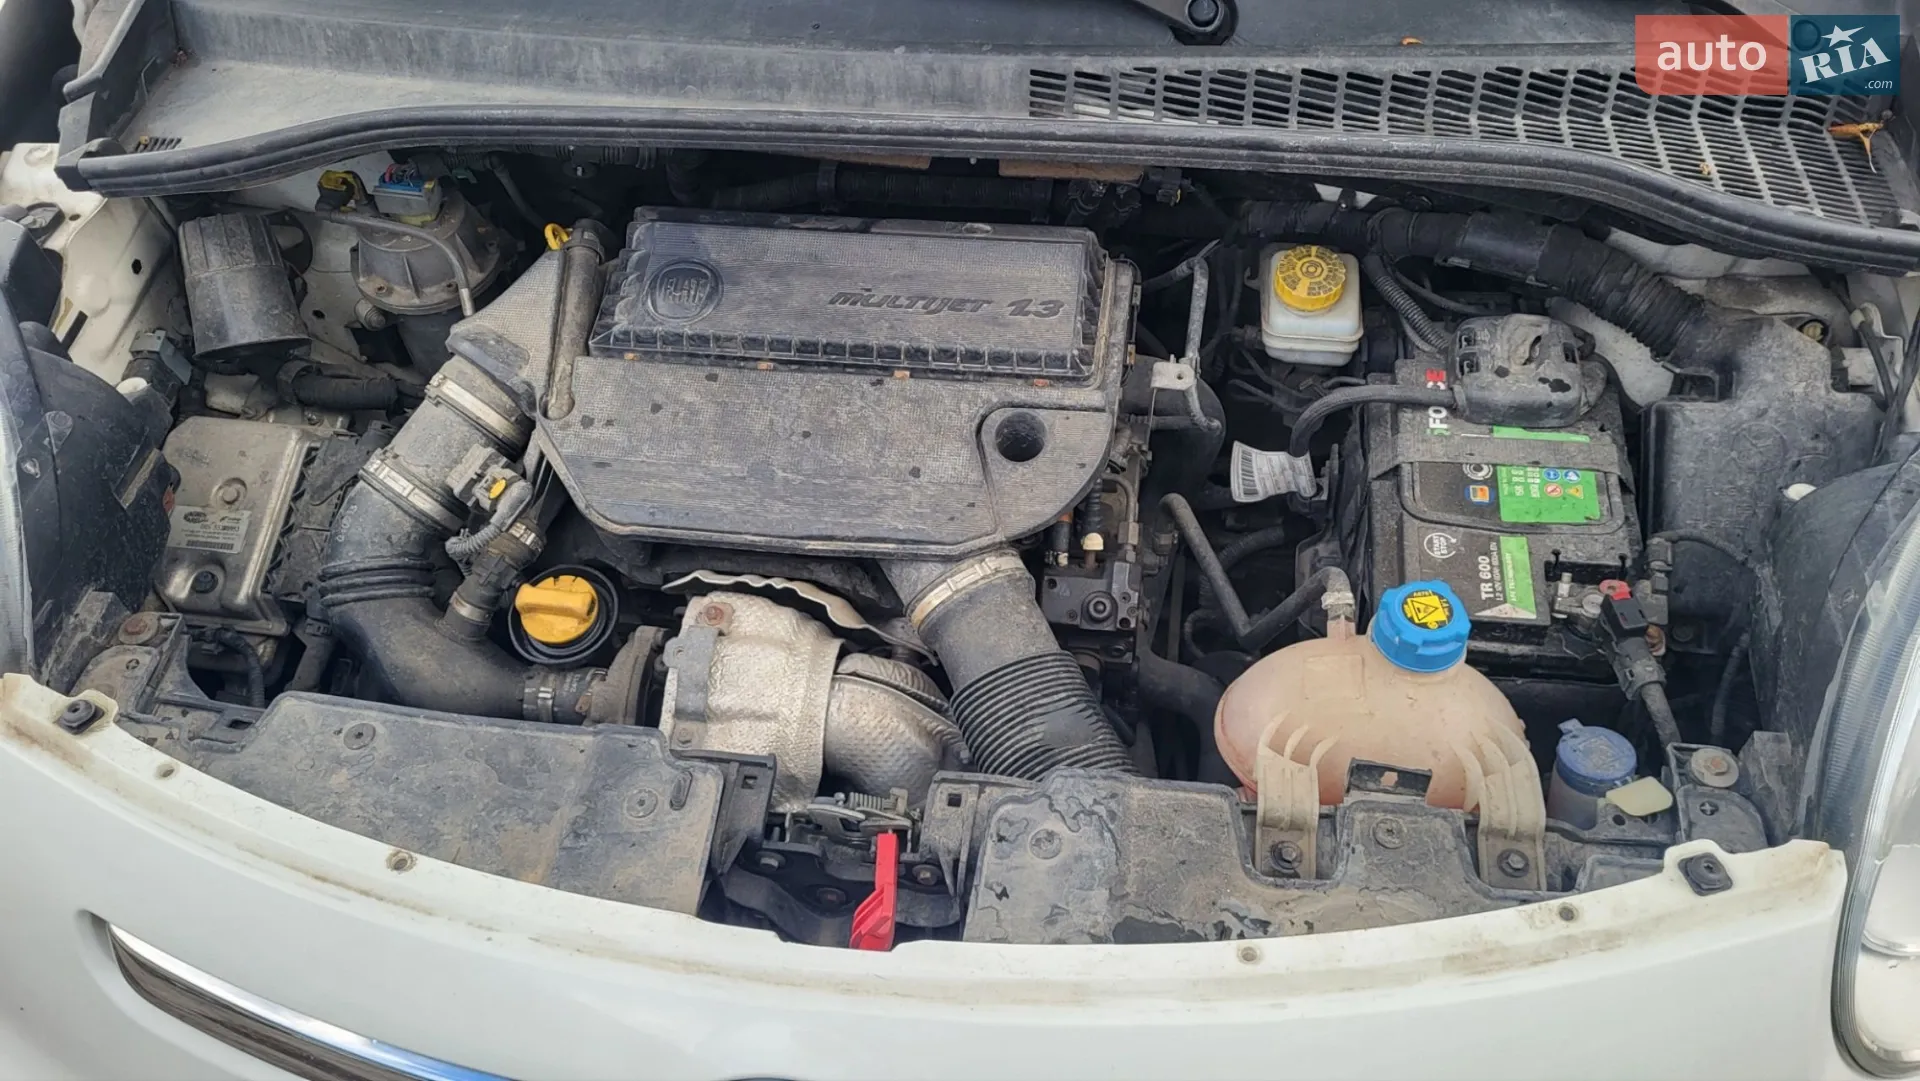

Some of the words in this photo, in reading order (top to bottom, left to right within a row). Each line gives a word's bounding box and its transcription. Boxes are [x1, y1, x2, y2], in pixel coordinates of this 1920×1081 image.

[1433, 535, 1441, 555] START
[1440, 537, 1448, 554] STOP
[1479, 555, 1492, 580] 600
[1481, 583, 1494, 600] TR
